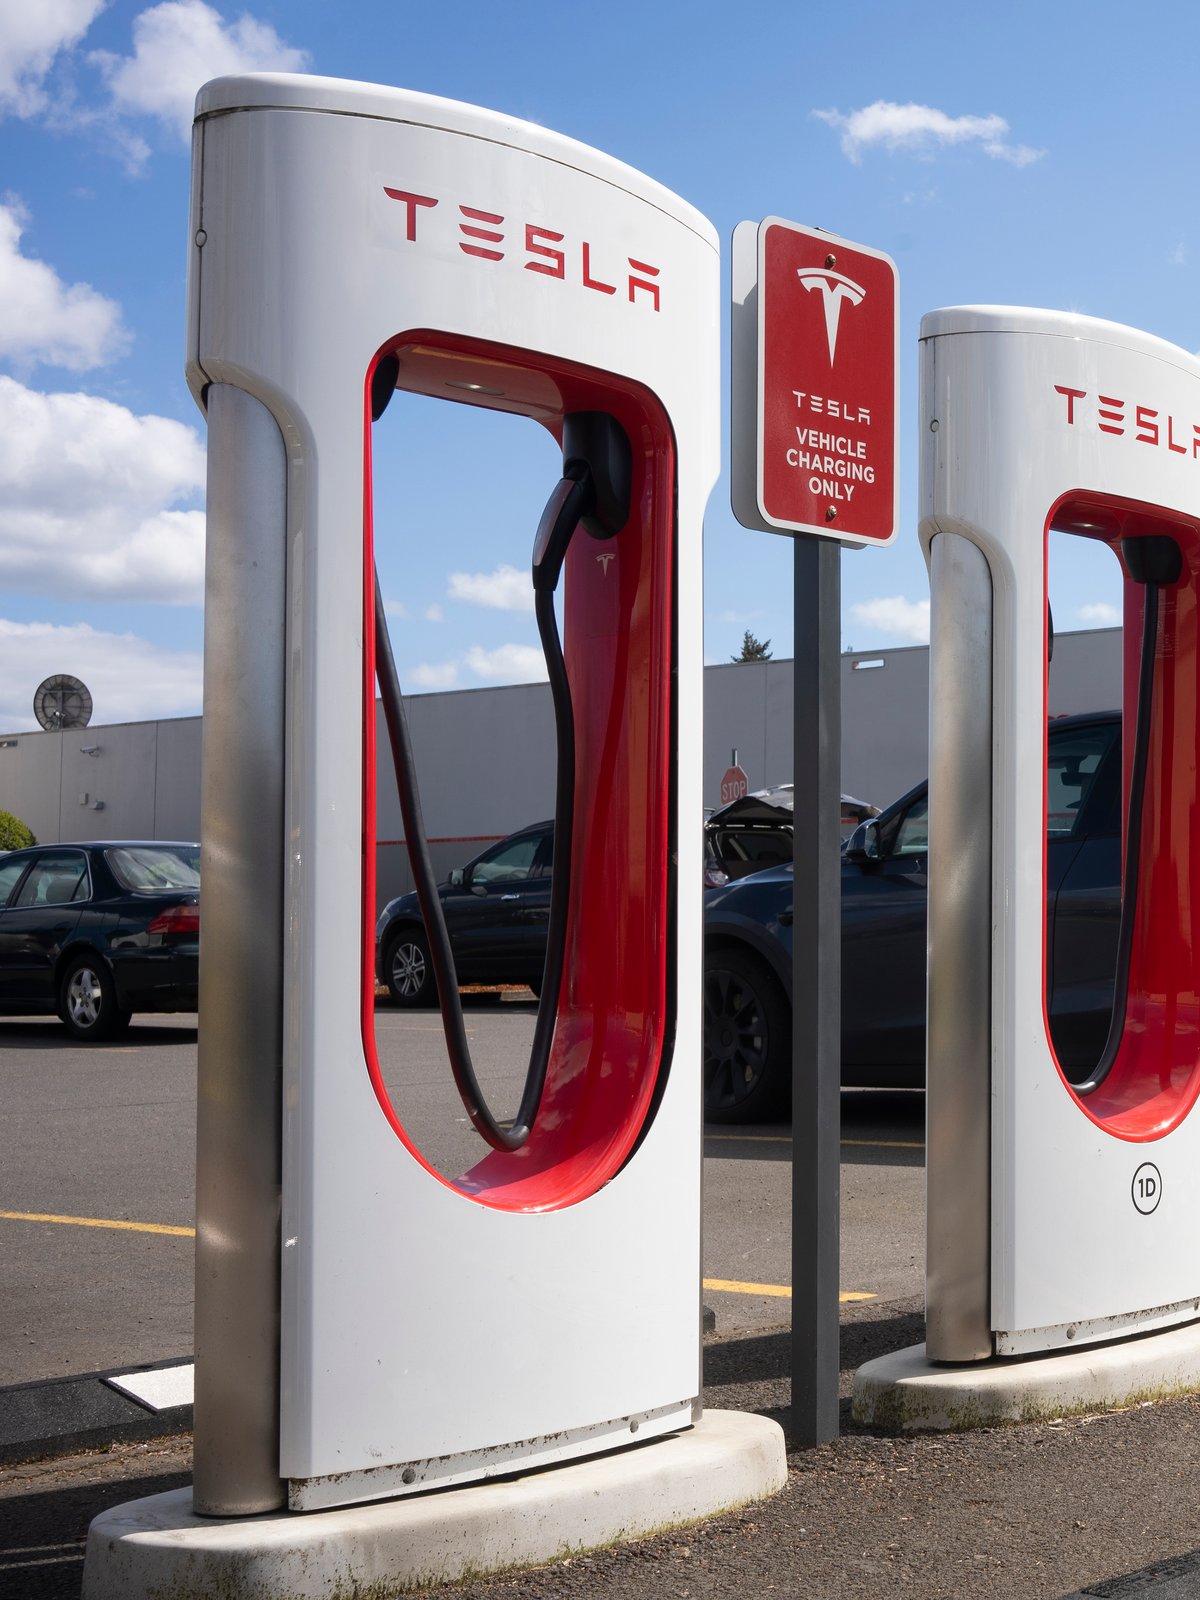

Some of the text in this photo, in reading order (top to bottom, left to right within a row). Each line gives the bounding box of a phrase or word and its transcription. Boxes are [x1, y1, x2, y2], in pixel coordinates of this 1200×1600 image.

[383, 186, 661, 313] TESLA
[791, 389, 871, 425] TESLA
[796, 426, 867, 460] VEHICLE
[786, 448, 875, 484] CHARGING
[808, 476, 855, 502] ONLY
[722, 781, 746, 800] STOP
[1138, 1177, 1156, 1198] 1D
